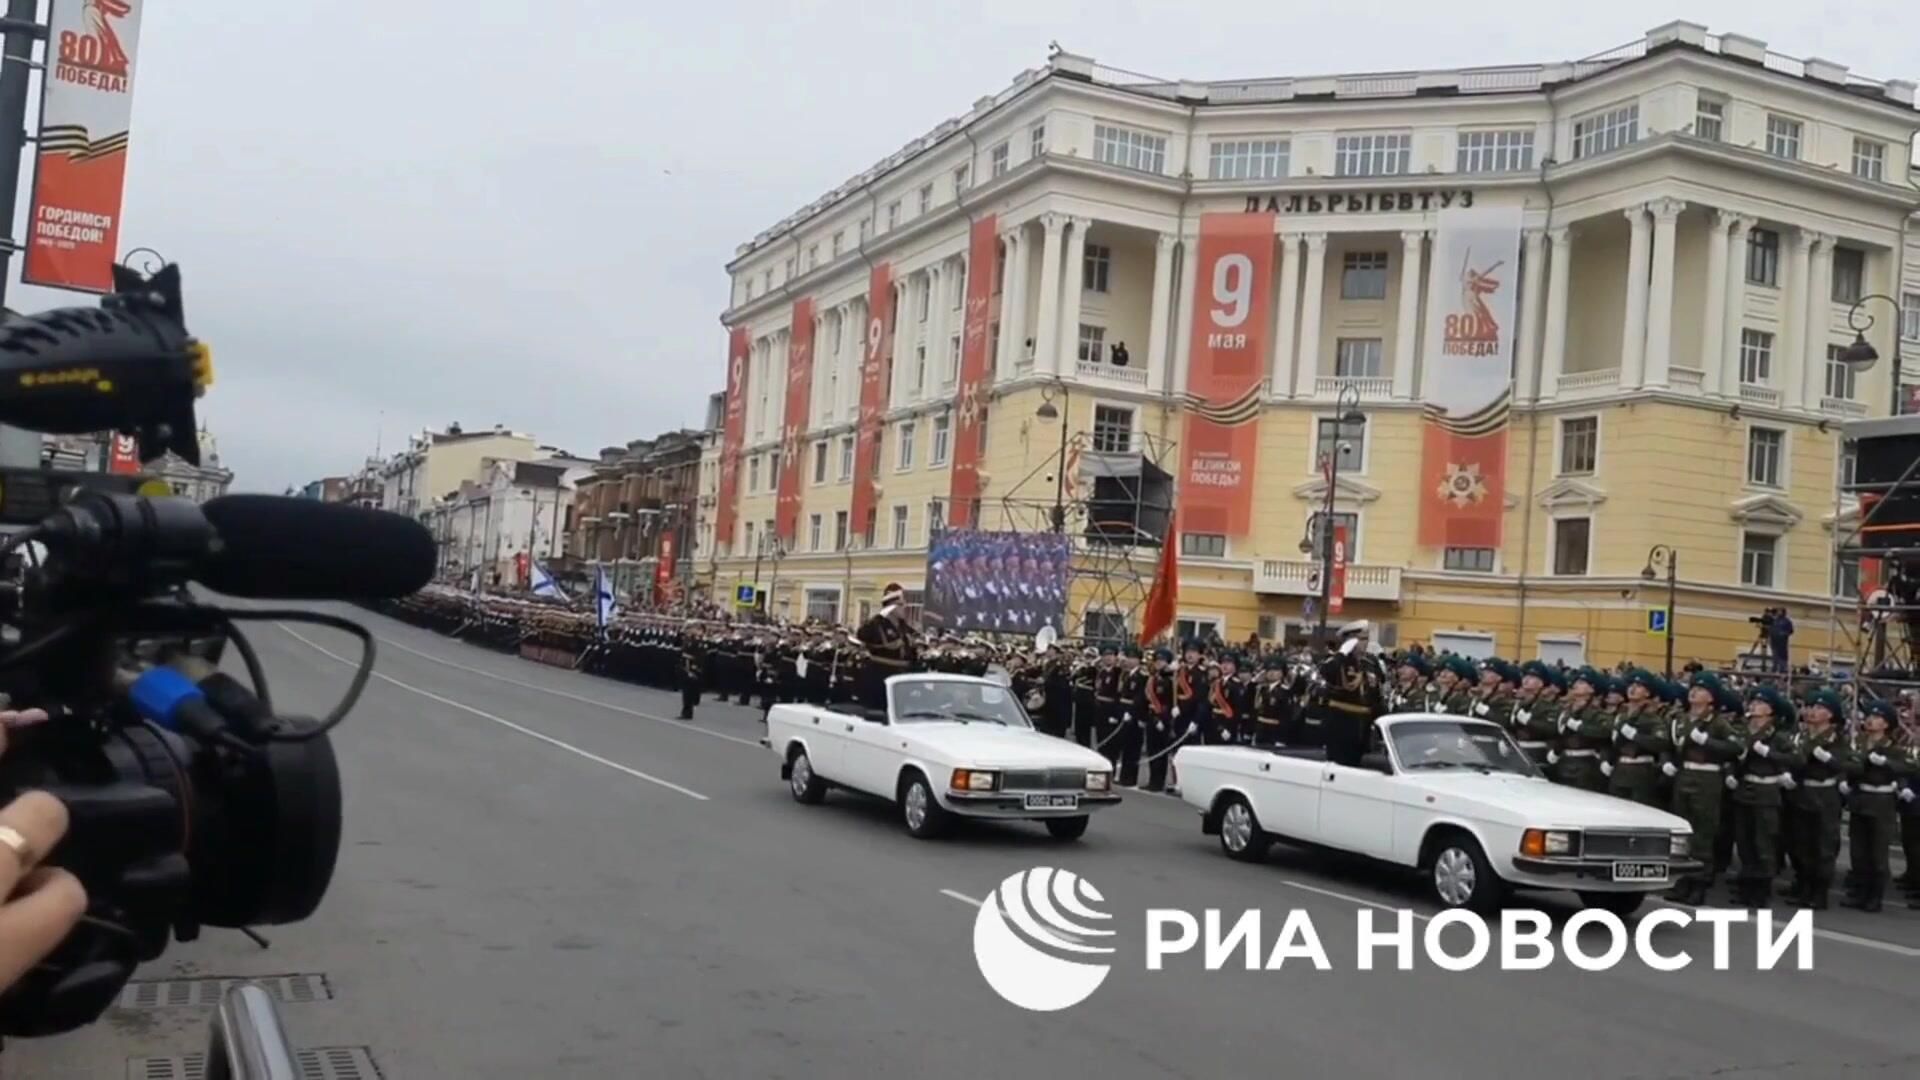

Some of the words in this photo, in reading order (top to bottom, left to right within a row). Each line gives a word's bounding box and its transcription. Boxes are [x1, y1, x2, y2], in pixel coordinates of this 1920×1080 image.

[59, 30, 98, 65] 80
[56, 64, 127, 93] ПОБЕДА!
[38, 205, 112, 229] ГОРДИМСЯ
[37, 221, 104, 244] ПОБЕДОЙ!
[1210, 252, 1253, 328] 9
[1445, 313, 1474, 339] 80
[1208, 333, 1246, 349] мая
[1442, 341, 1499, 358] ПОБЕДА!
